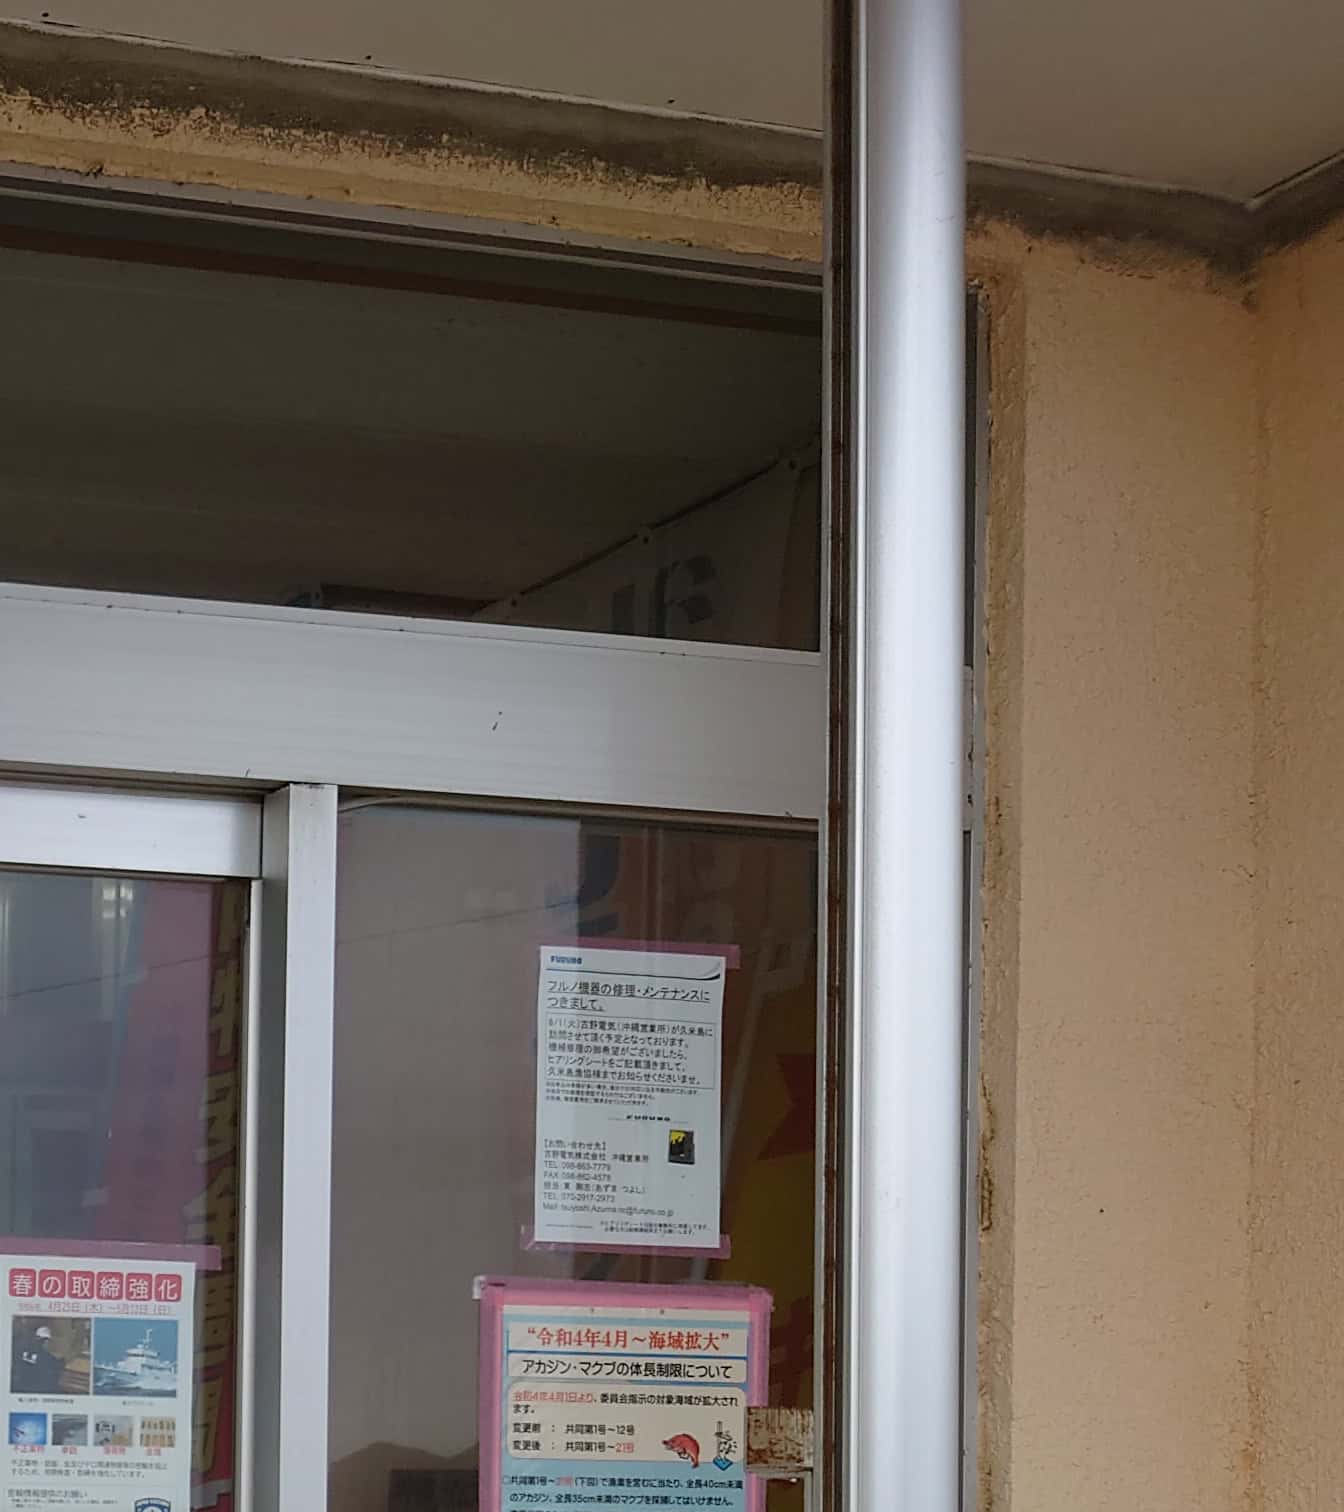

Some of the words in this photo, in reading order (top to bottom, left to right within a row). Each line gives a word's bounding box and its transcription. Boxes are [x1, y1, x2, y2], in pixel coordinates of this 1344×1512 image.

[13, 1274, 178, 1300] 春の取締強化
